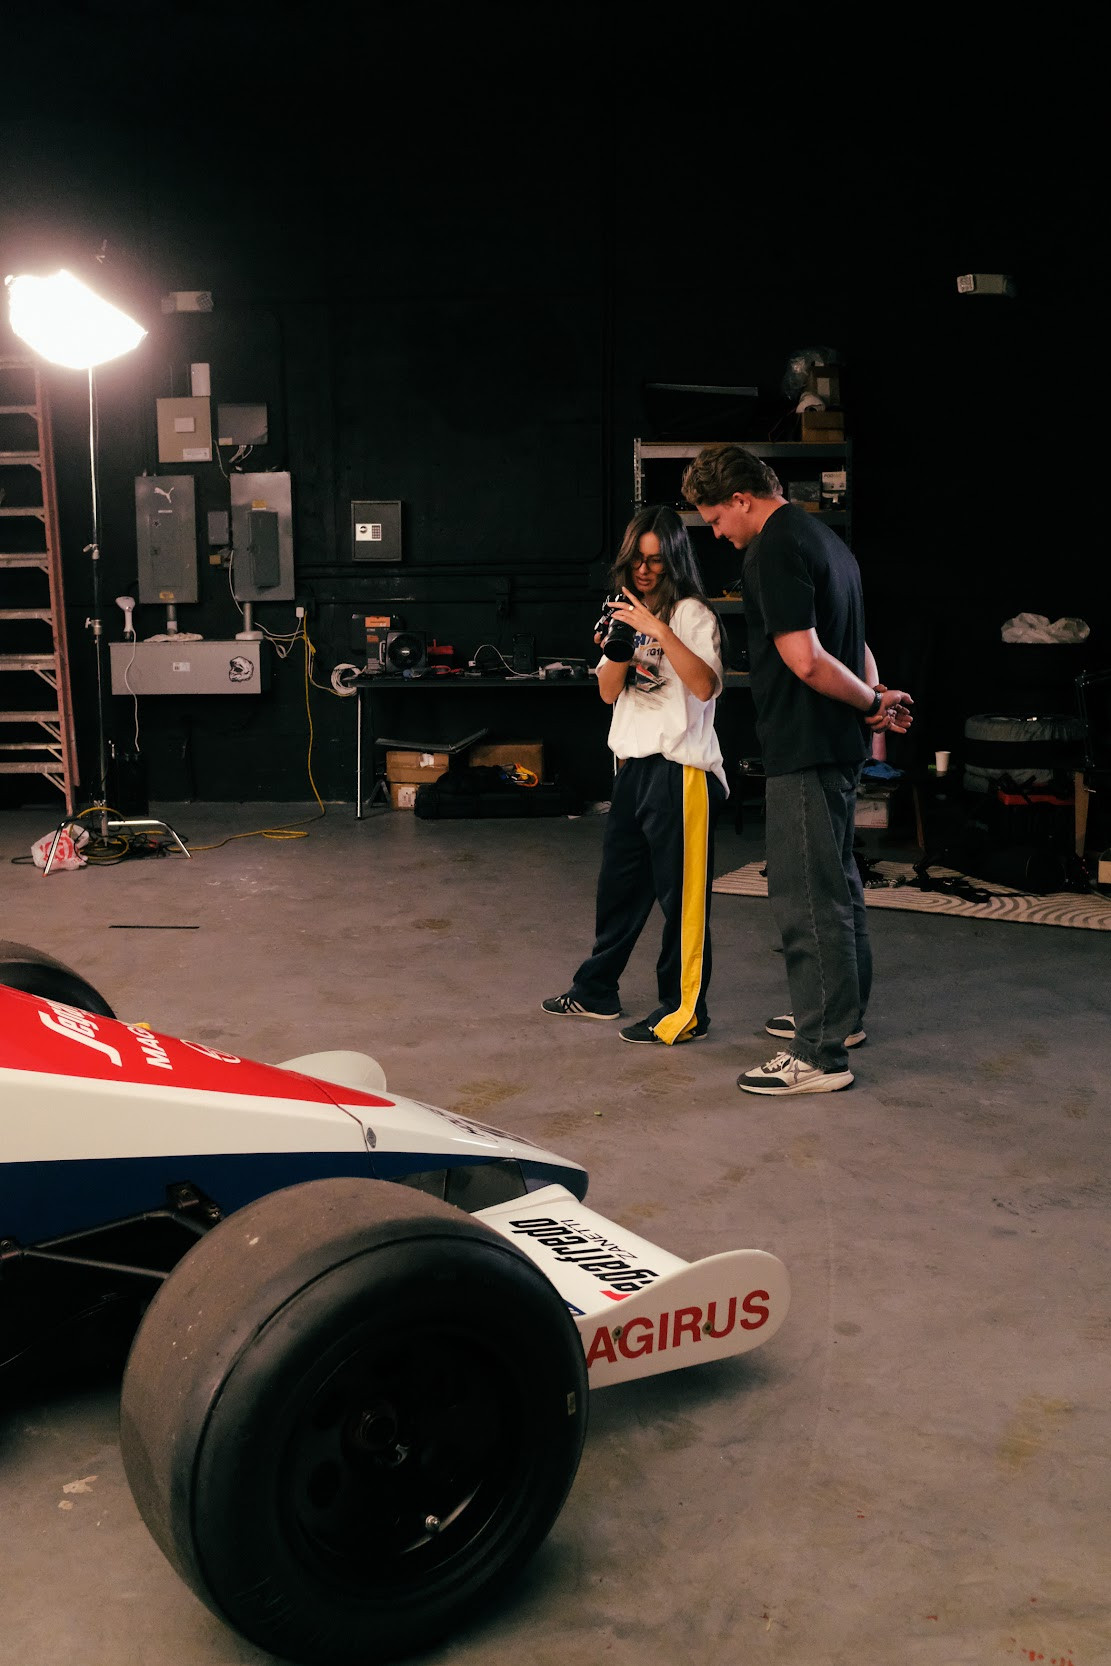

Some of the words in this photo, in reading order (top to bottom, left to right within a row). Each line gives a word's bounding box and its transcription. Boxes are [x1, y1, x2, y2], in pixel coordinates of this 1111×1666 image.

[127, 1025, 173, 1070] MAG
[508, 1218, 660, 1301] egafredo
[560, 1219, 638, 1260] ZANETTI
[586, 1289, 770, 1369] AGIRUS
